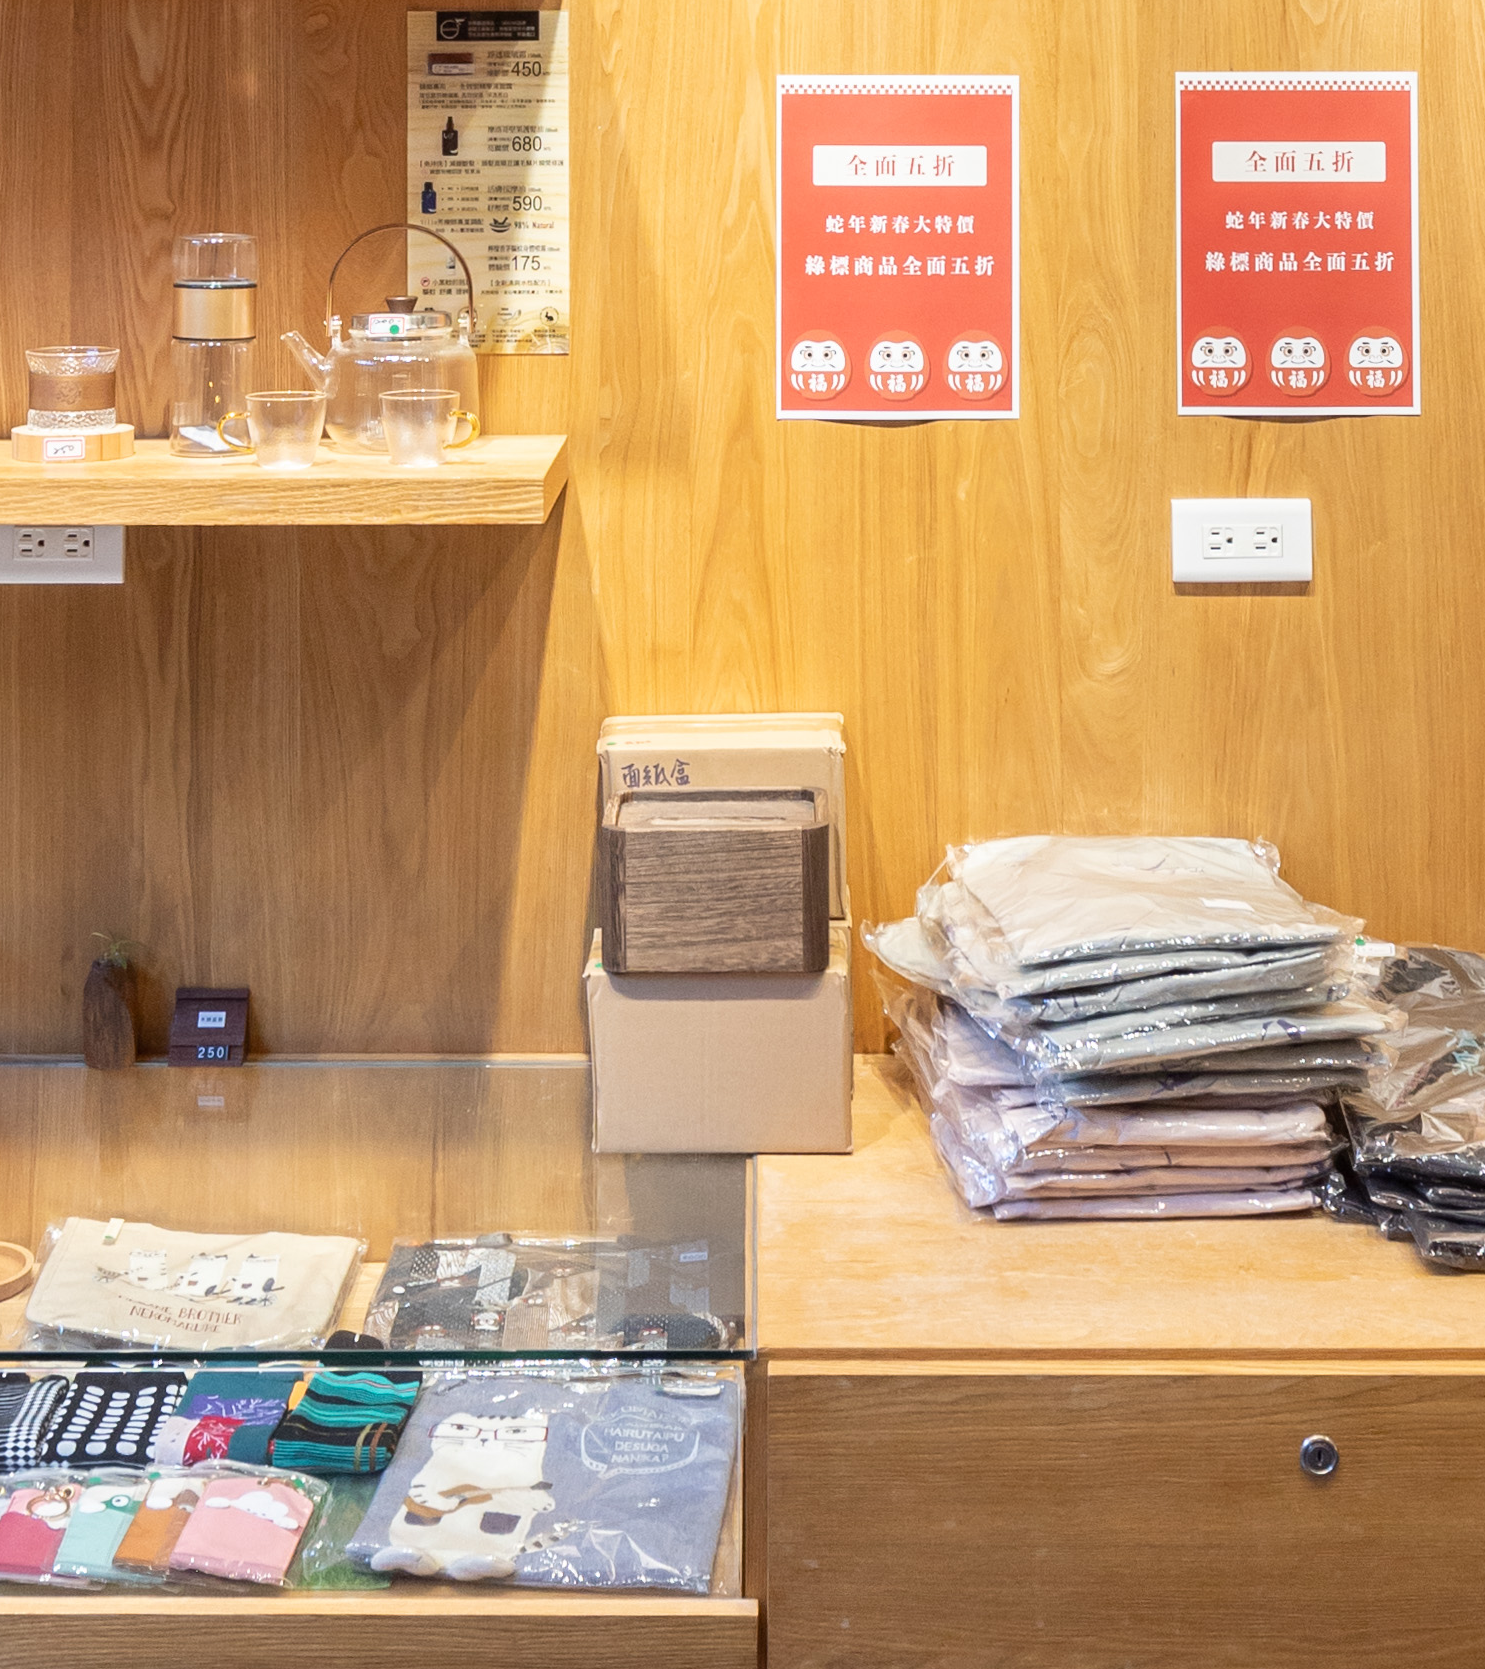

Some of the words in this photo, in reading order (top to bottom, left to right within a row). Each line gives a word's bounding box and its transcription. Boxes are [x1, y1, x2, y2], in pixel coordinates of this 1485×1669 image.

[511, 61, 542, 77] 450
[512, 136, 542, 152] 680
[847, 154, 956, 177] 全面五折
[1245, 150, 1354, 173] 全面五折
[512, 195, 543, 212] 590
[825, 215, 975, 234] 蛇年新春大特價
[1225, 211, 1375, 230] 蛇年新春大特價
[512, 256, 541, 271] 175
[805, 255, 995, 276] 綠標商品全面五折
[1205, 252, 1395, 272] 綠標商品全面五折
[807, 373, 827, 393] 福
[887, 373, 907, 393] 福
[965, 373, 984, 393] 福
[1209, 369, 1228, 389] 福
[1288, 369, 1308, 389] 福
[1366, 369, 1385, 389] 福
[621, 759, 690, 788] 面紙盒
[198, 1047, 224, 1058] 250
[179, 1308, 243, 1326] BROTHER
